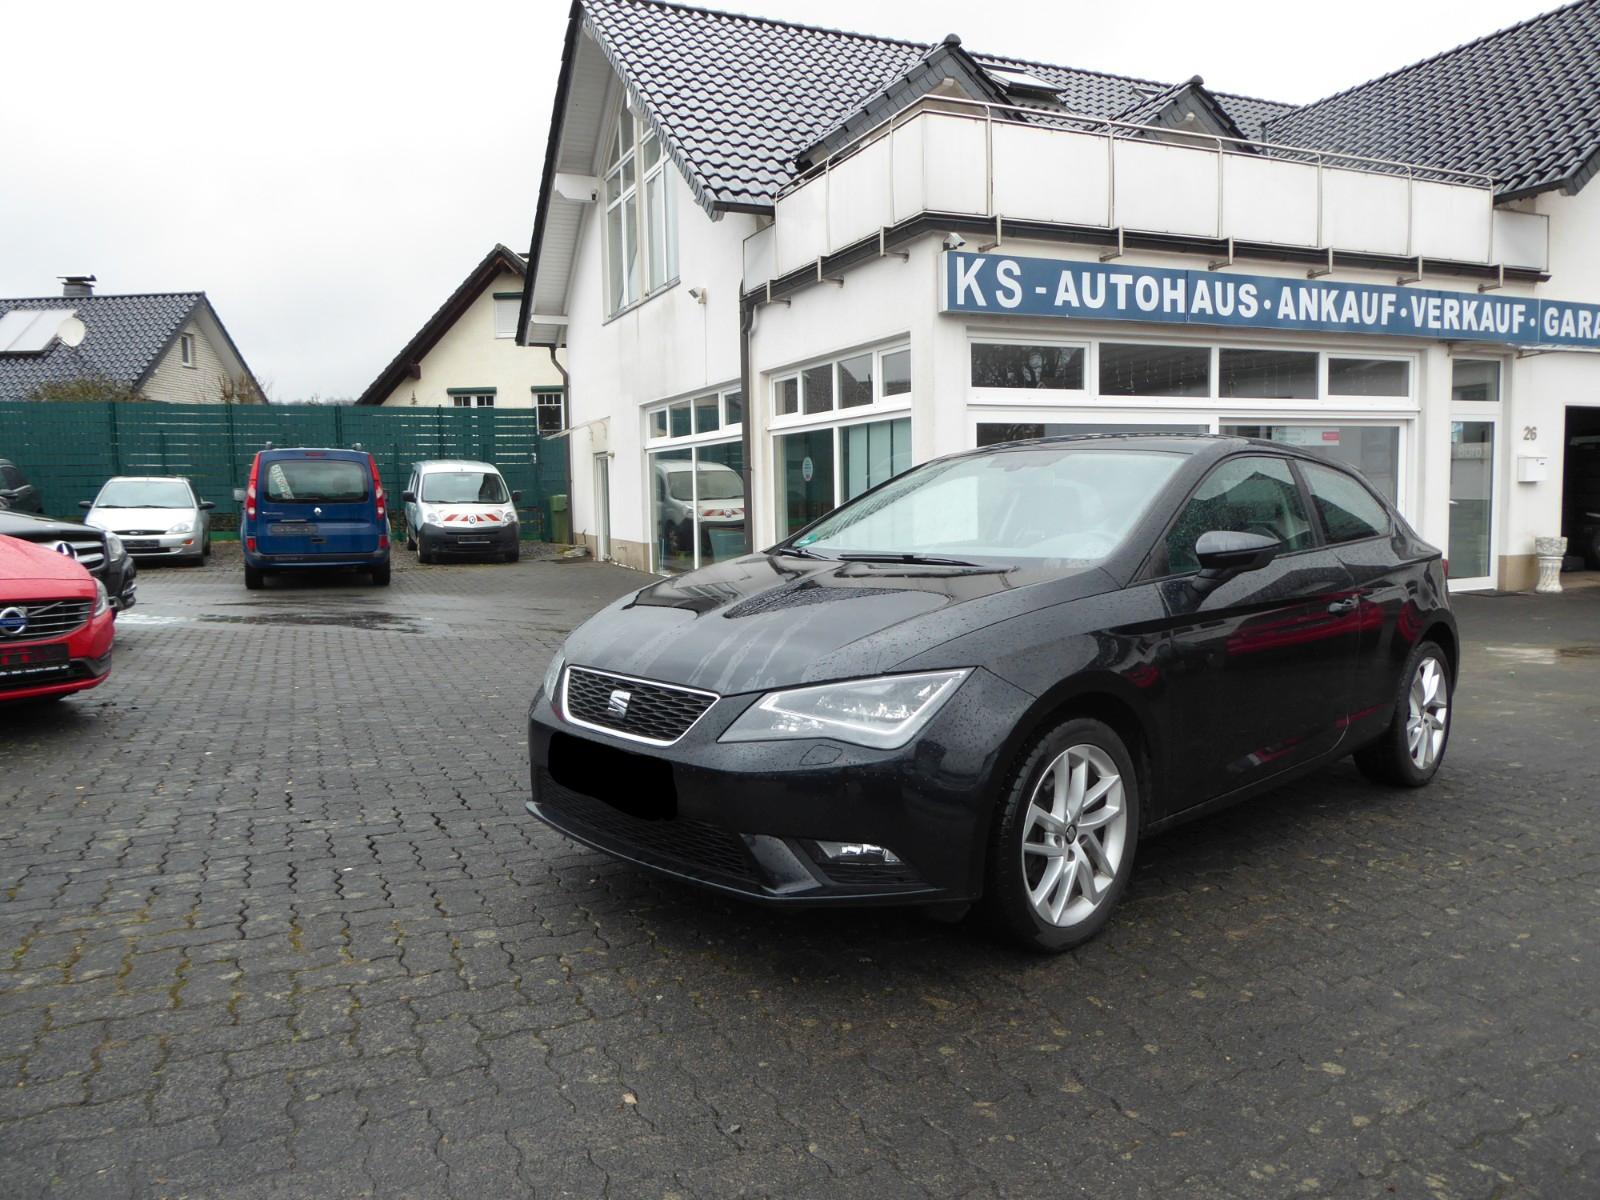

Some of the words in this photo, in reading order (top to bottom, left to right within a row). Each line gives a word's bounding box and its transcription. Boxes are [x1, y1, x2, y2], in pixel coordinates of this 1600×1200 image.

[1054, 270, 1258, 318] AUTOHAUS
[1277, 286, 1397, 325] ANKAUF
[1411, 296, 1526, 334] VERKAUF
[1523, 426, 1538, 441] 26
